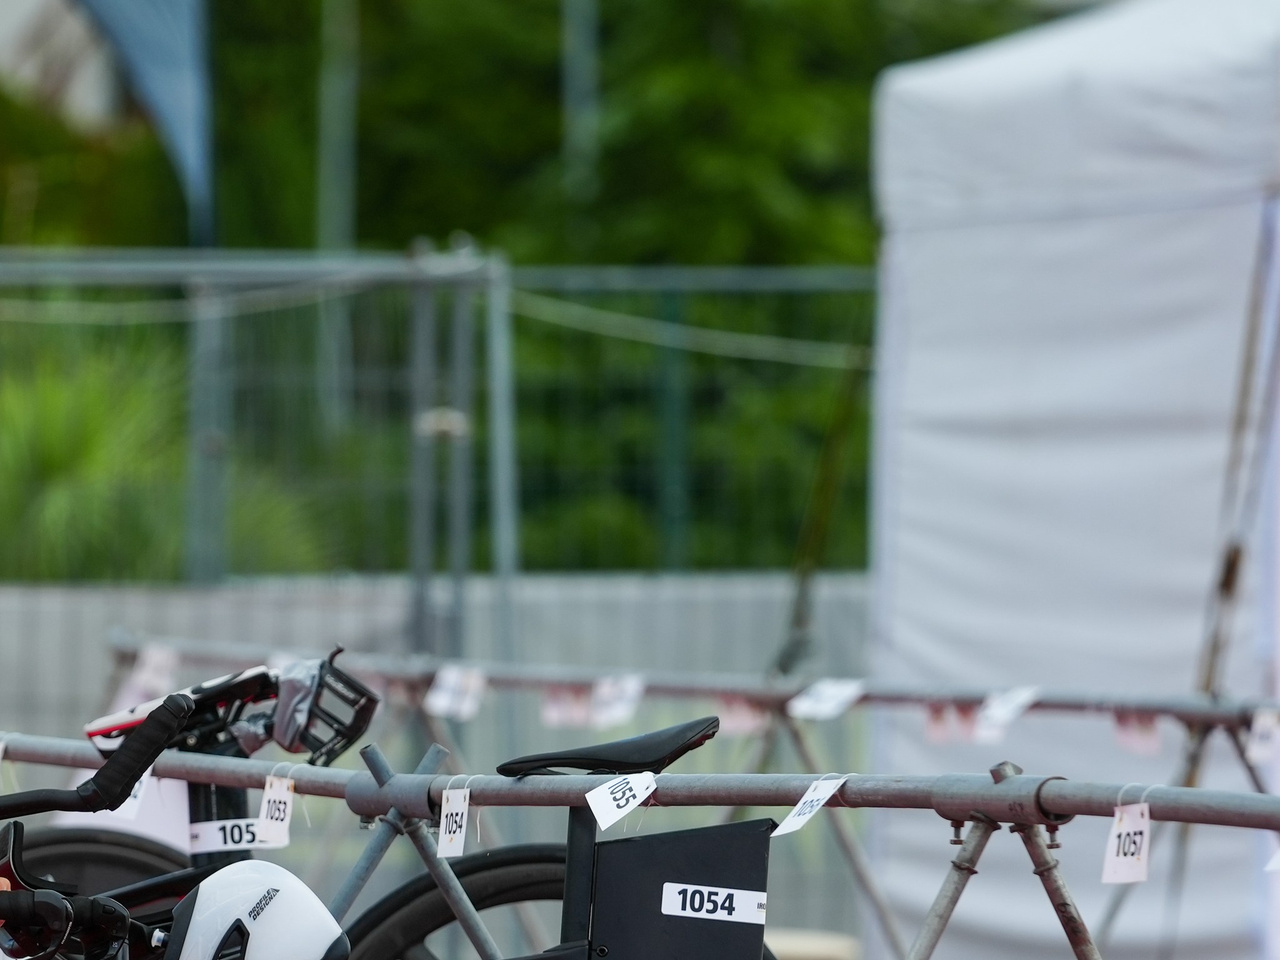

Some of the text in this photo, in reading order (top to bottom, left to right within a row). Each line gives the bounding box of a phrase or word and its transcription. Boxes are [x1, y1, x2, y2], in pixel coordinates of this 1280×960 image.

[608, 777, 637, 810] 1055
[265, 798, 287, 822] 1053
[444, 812, 464, 835] 1054
[218, 822, 269, 846] 105
[1116, 829, 1144, 858] 1057
[248, 887, 274, 919] PROFILE
[252, 894, 277, 921] DESIGN
[677, 887, 736, 916] 1054
